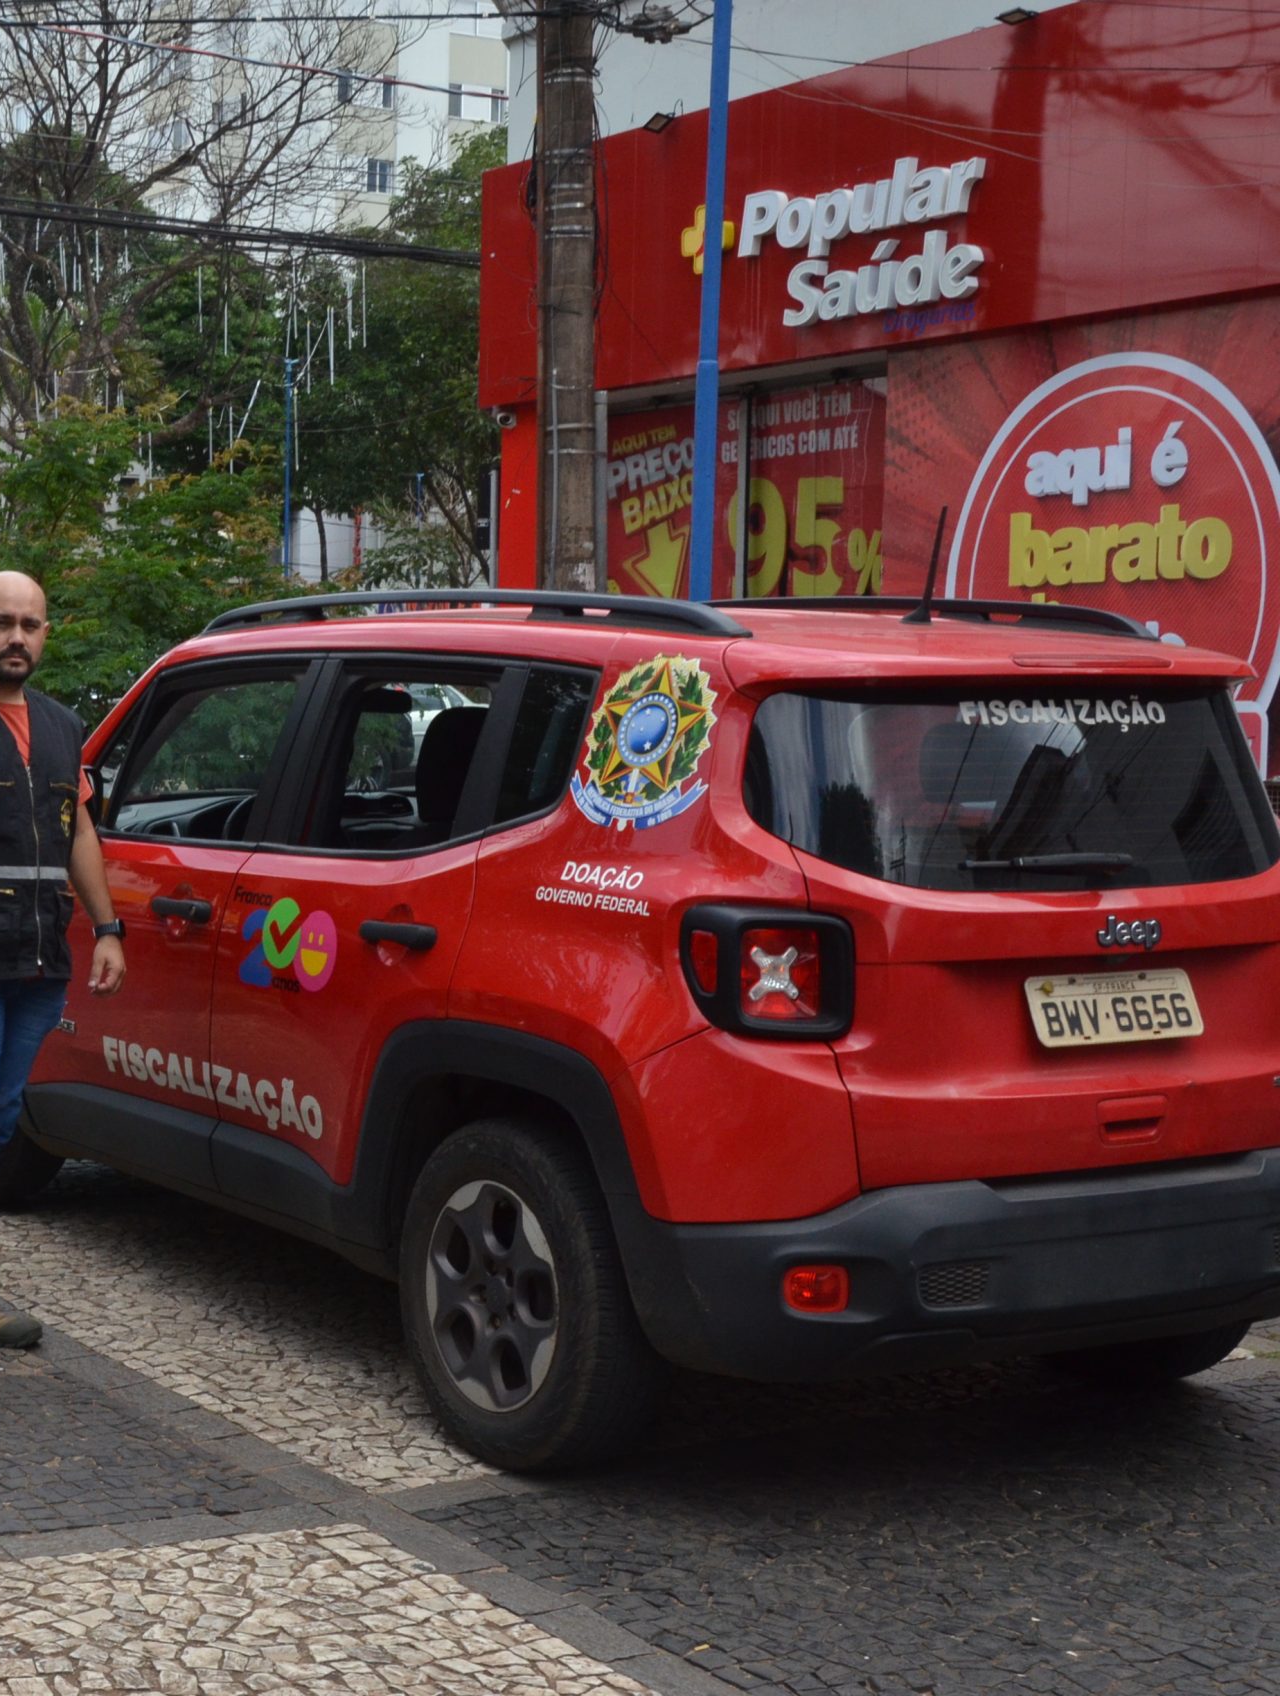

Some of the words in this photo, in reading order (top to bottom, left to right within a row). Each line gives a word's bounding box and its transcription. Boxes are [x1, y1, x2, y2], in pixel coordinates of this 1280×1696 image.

[737, 156, 987, 258] Popular
[782, 229, 985, 327] Saúde
[612, 431, 647, 457] AQUI
[798, 428, 830, 455] COM
[833, 420, 859, 450] ATÉ
[1024, 426, 1132, 506] aqui
[1150, 420, 1189, 487] é
[1008, 503, 1233, 587] barato
[959, 695, 1166, 732] FISCALIZAÇÃO
[560, 861, 644, 891] DOAÇÃO
[235, 885, 273, 906] Franca
[535, 886, 593, 908] GOVERNO
[594, 894, 650, 917] FEDERAL
[1098, 915, 1162, 948] Jeep
[102, 1035, 323, 1139] FISCALIZAÇÃO
